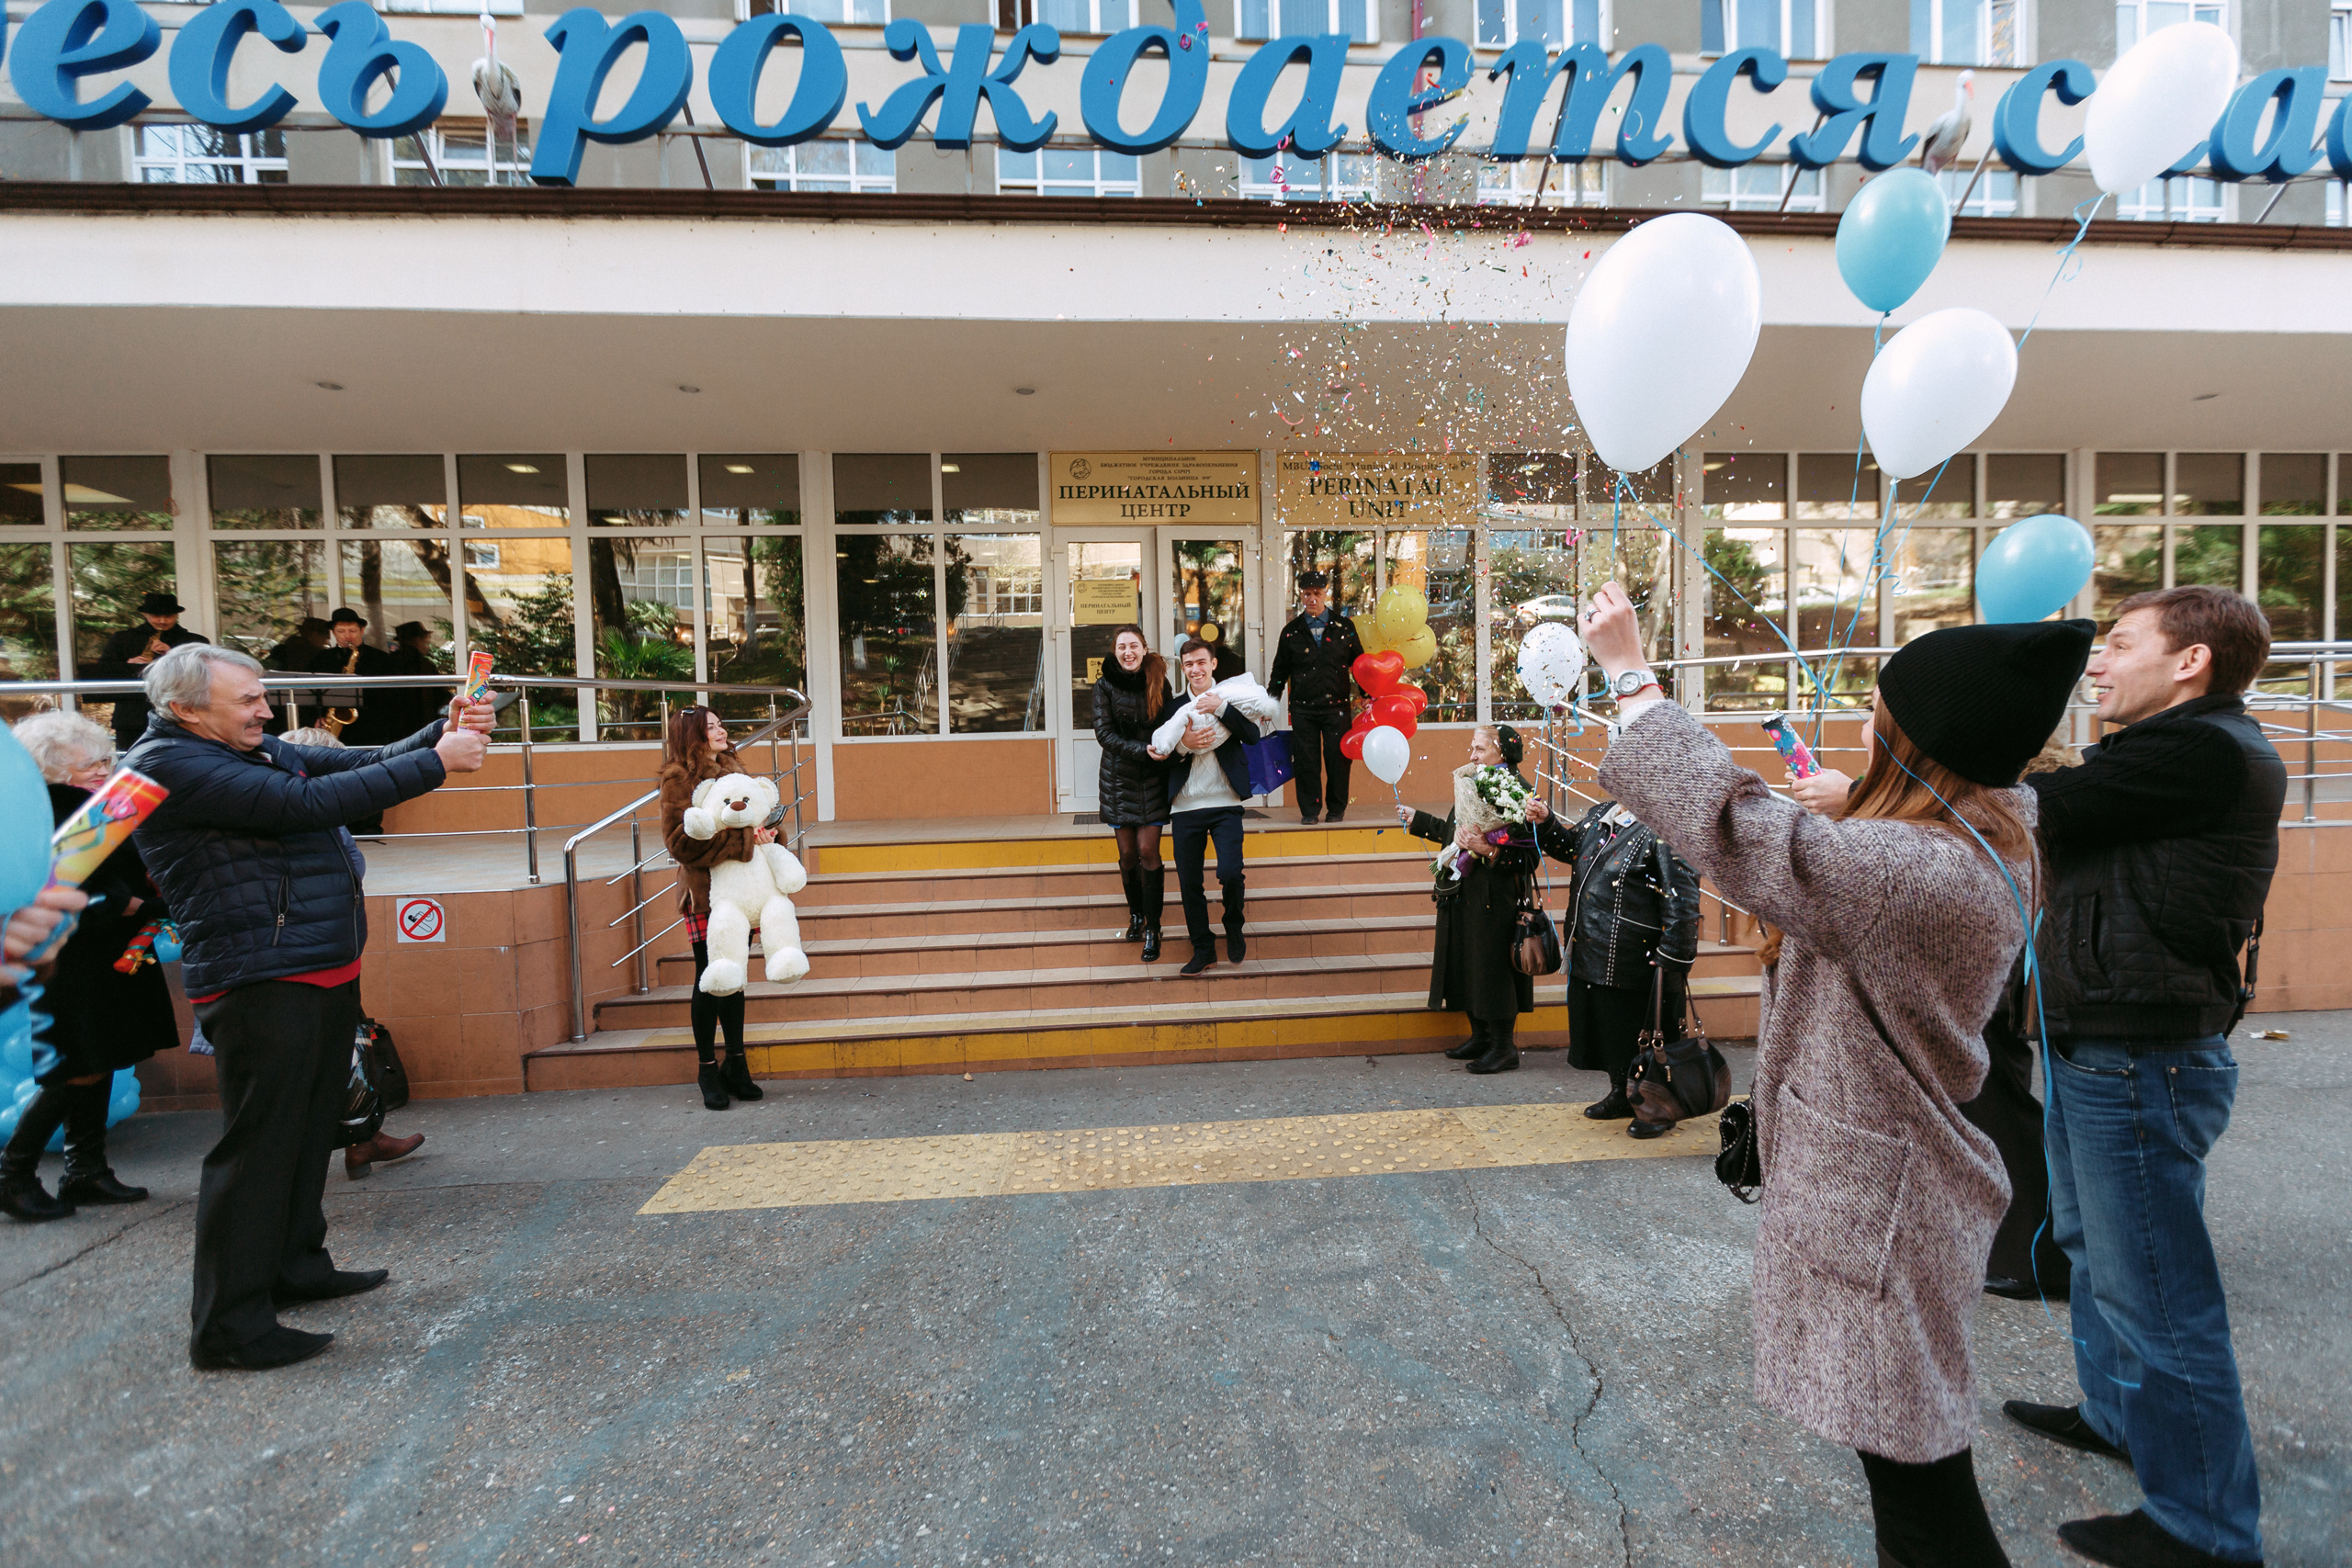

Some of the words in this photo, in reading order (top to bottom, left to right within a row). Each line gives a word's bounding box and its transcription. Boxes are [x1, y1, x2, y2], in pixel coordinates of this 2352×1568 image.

[0, 0, 448, 140] есь
[530, 0, 1920, 186] рождается
[1058, 481, 1250, 500] ПЕРИНАТАЛЬНЫЙ
[1308, 477, 1448, 496] PERINATAL
[1121, 503, 1191, 521] ЦЕНТР
[1349, 500, 1410, 519] UNIT
